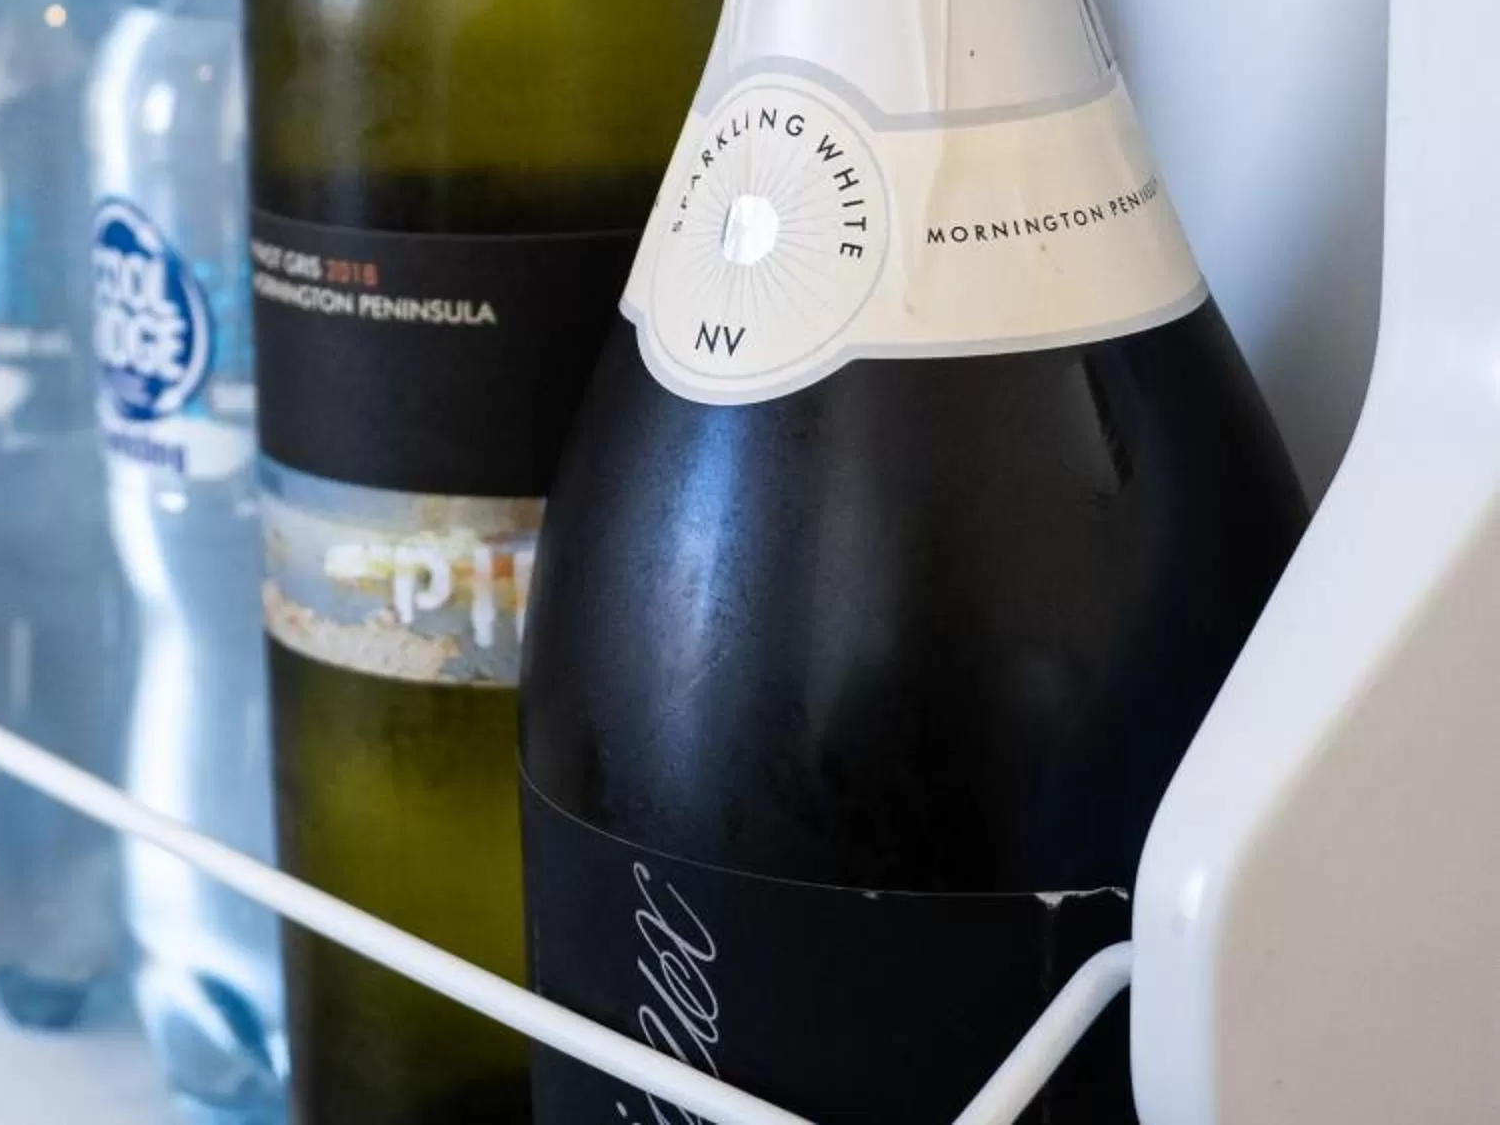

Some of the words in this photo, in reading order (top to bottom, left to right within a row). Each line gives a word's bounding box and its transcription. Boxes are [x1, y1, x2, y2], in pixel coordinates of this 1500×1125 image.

[815, 133, 867, 259] WHITE
[926, 202, 1106, 246] MORNINGTON
[282, 249, 322, 280] GRIS
[324, 259, 380, 289] 2018
[358, 292, 497, 326] PENINSULA
[694, 320, 747, 357] NV
